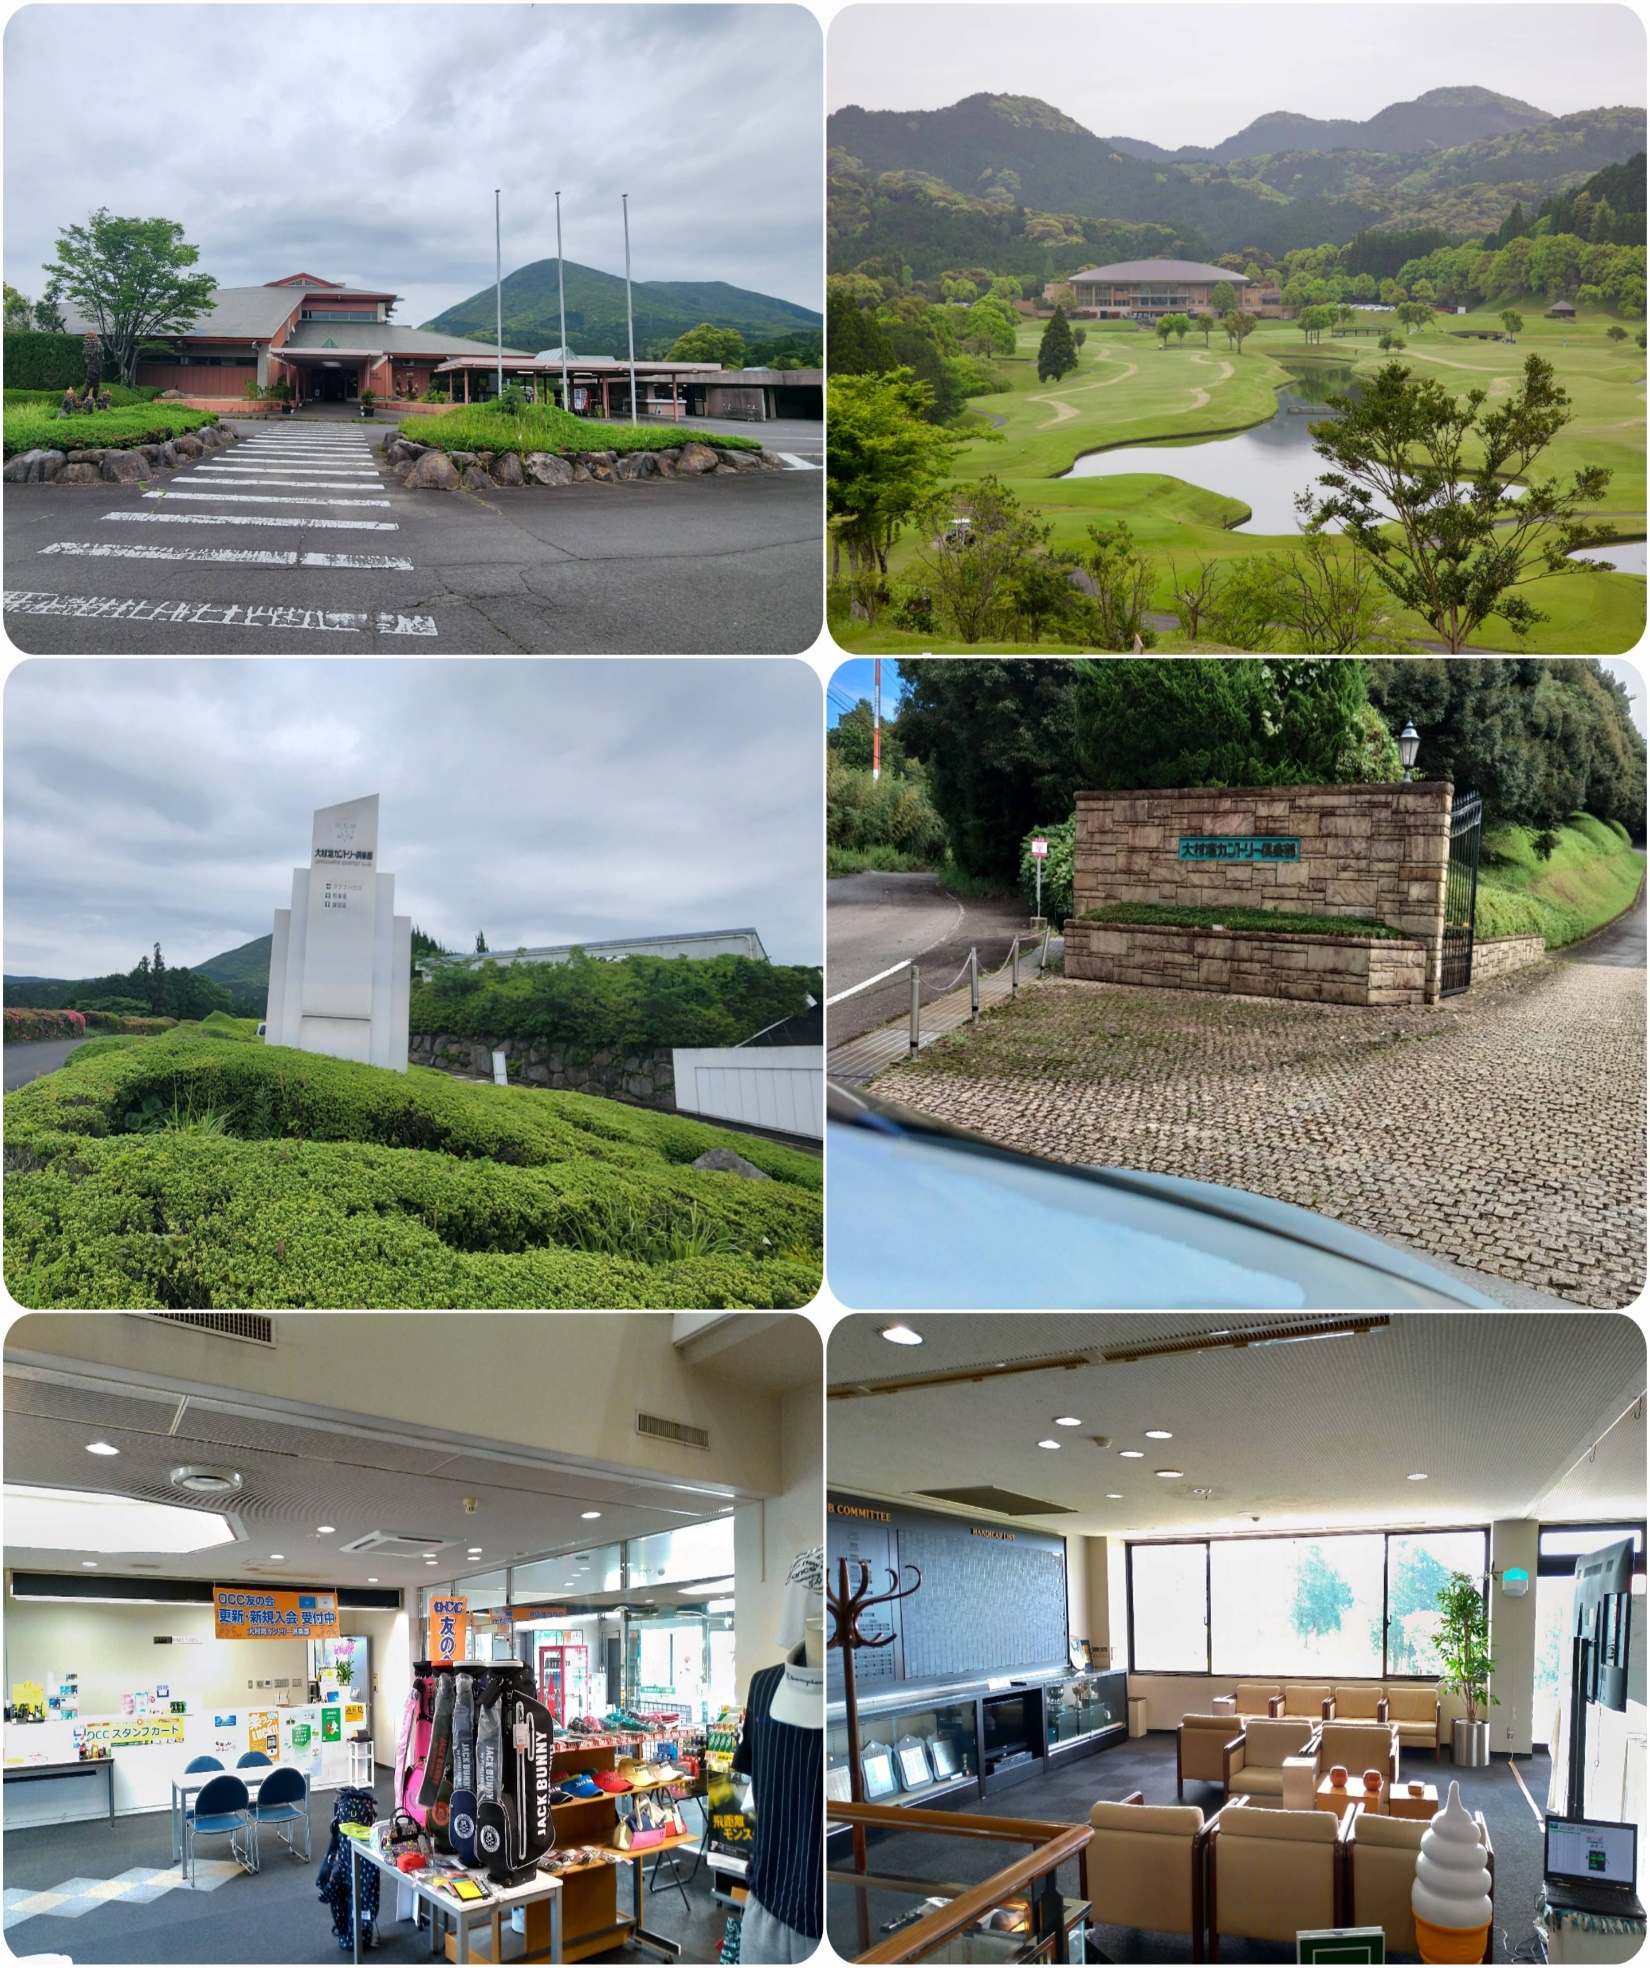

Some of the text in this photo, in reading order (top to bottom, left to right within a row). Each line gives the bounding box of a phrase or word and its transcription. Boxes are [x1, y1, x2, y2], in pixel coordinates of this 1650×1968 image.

[837, 1504, 891, 1522] COMMITTEE
[972, 1527, 1016, 1541] HANDICAP LIST
[218, 1593, 275, 1607] OCC友の会
[301, 1611, 336, 1625] 受付中
[461, 1743, 470, 1763] JACK
[485, 1745, 494, 1767] JACK
[535, 1731, 547, 1836] JACK BUNNY
[712, 1813, 745, 1829] 飛距離
[723, 1828, 754, 1842] モンス
